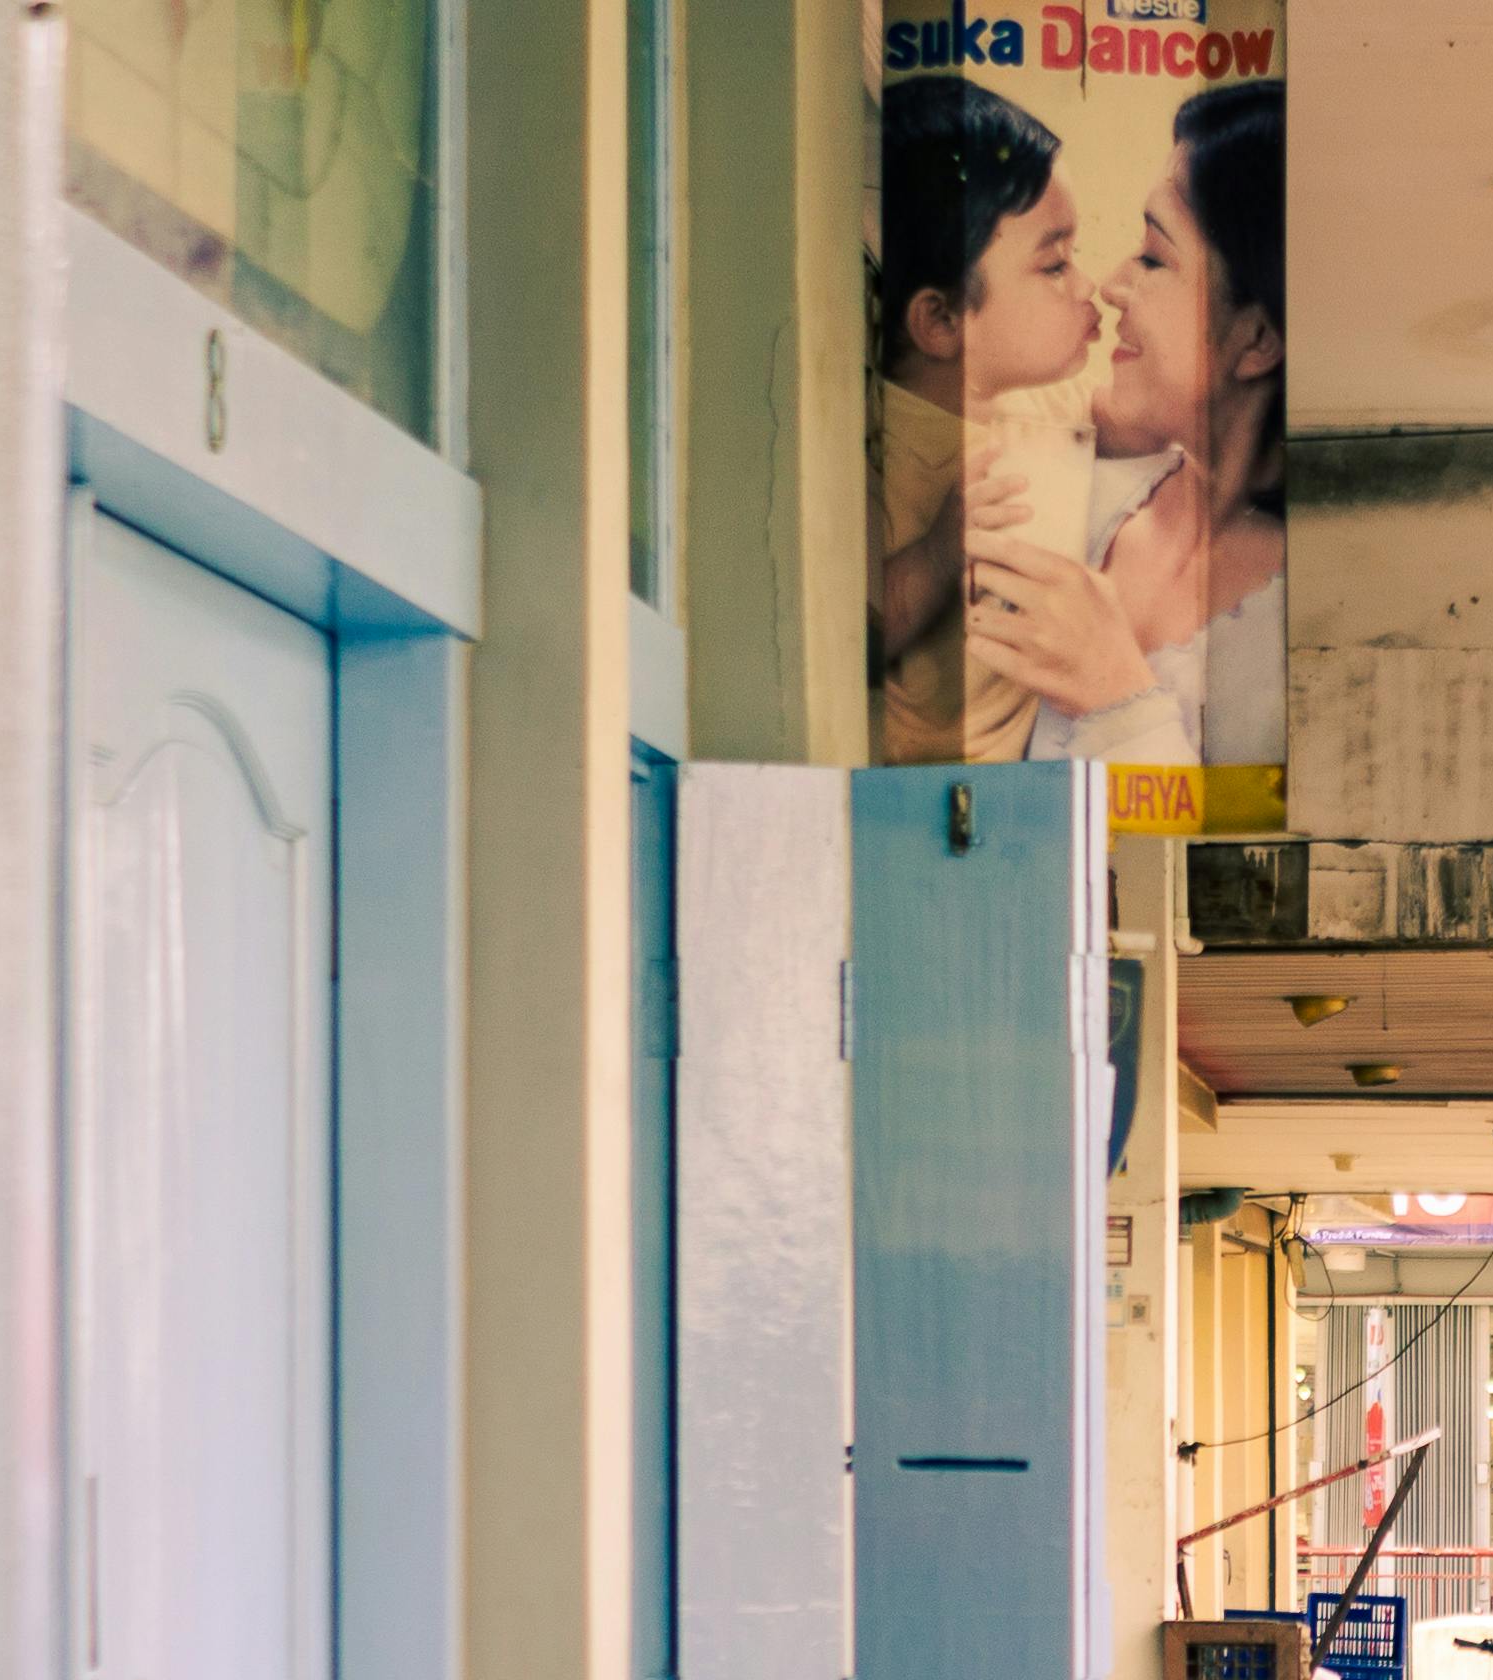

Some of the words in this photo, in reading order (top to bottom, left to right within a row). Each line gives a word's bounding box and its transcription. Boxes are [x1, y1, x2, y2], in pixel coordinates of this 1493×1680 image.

[886, 0, 1023, 71] suka
[1041, 5, 1275, 80] Dancow
[205, 329, 226, 454] 8
[1108, 774, 1196, 820] URYA
